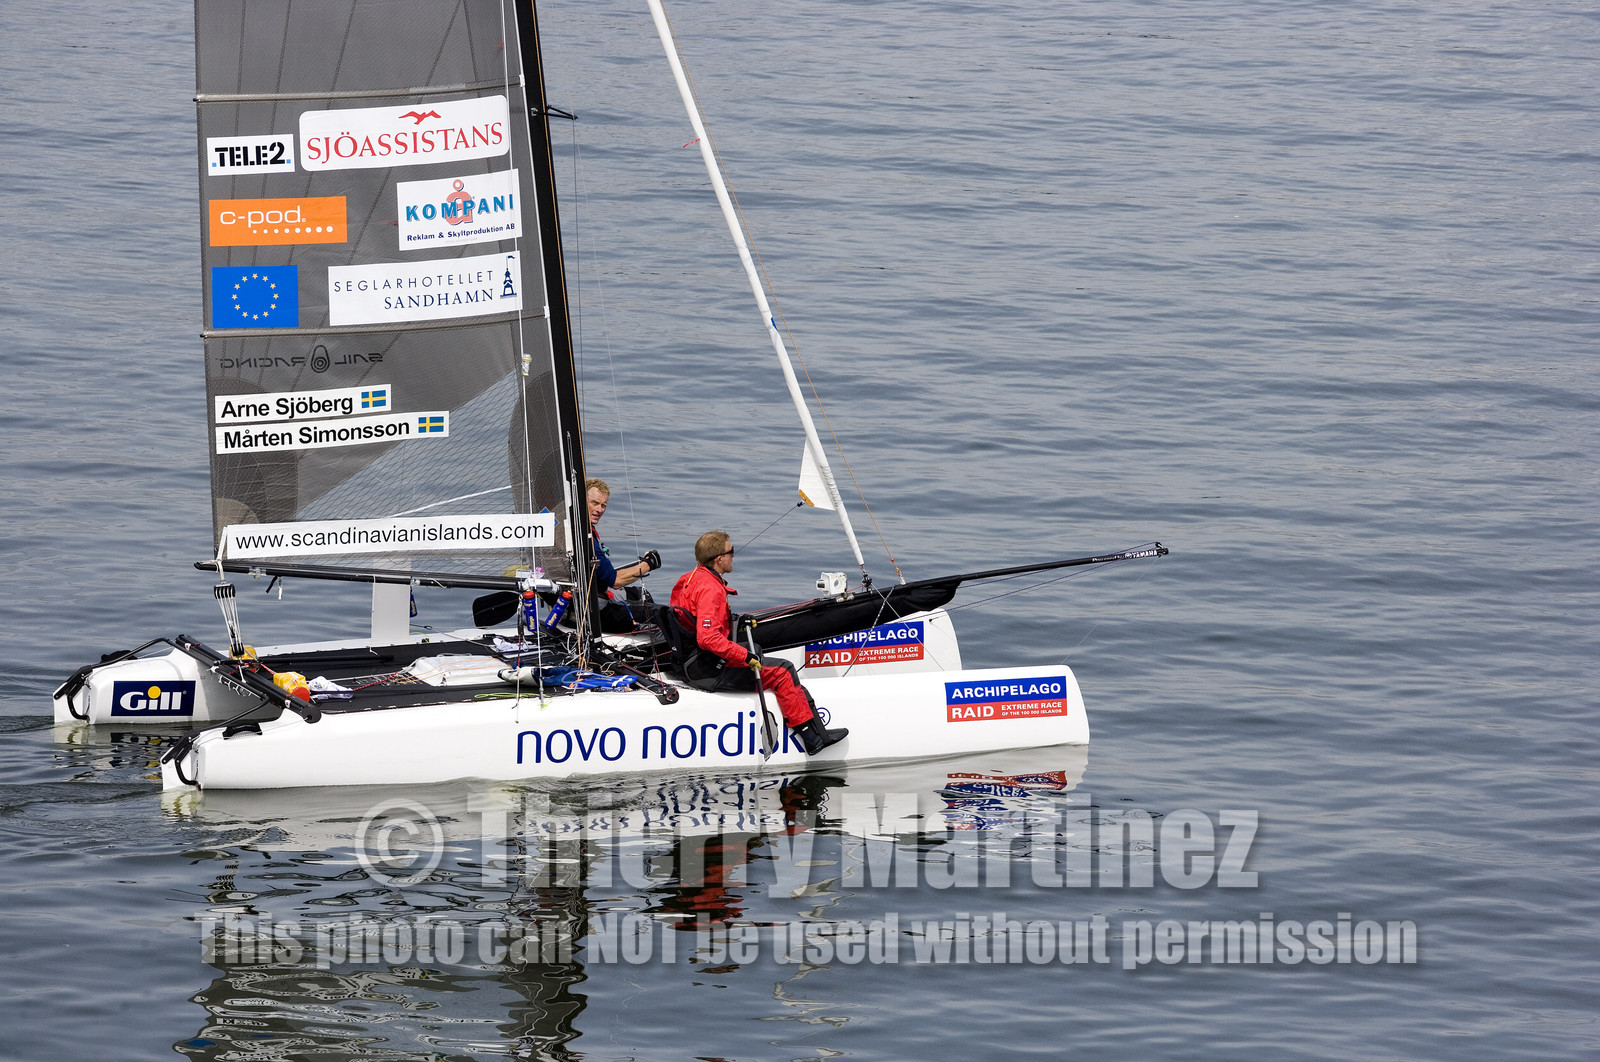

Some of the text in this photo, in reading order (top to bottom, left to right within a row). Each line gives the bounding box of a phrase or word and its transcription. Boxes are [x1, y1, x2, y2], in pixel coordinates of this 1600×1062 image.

[307, 121, 503, 164] SJÖASSISTANS
[405, 193, 515, 222] KOMPANI
[407, 232, 435, 242] Reklam
[447, 225, 504, 239] Skyltproduktion
[505, 222, 516, 231] AB
[333, 270, 494, 293] SEGLARHOTELLET
[384, 288, 494, 310] SANDHAMN
[221, 396, 354, 419] Arne Sjöberg
[223, 421, 410, 449] Mårten Simonsson
[235, 523, 545, 550] www.scandinavianislands.com
[810, 628, 918, 646] CHIPELAGO
[809, 652, 852, 665] RAID
[859, 648, 896, 657] EXTREME
[119, 686, 182, 711] Gill
[951, 682, 1061, 699] ARCHIPELAGO
[951, 706, 995, 719] RAID
[1001, 703, 1039, 711] EXTREME
[516, 727, 627, 764] novo
